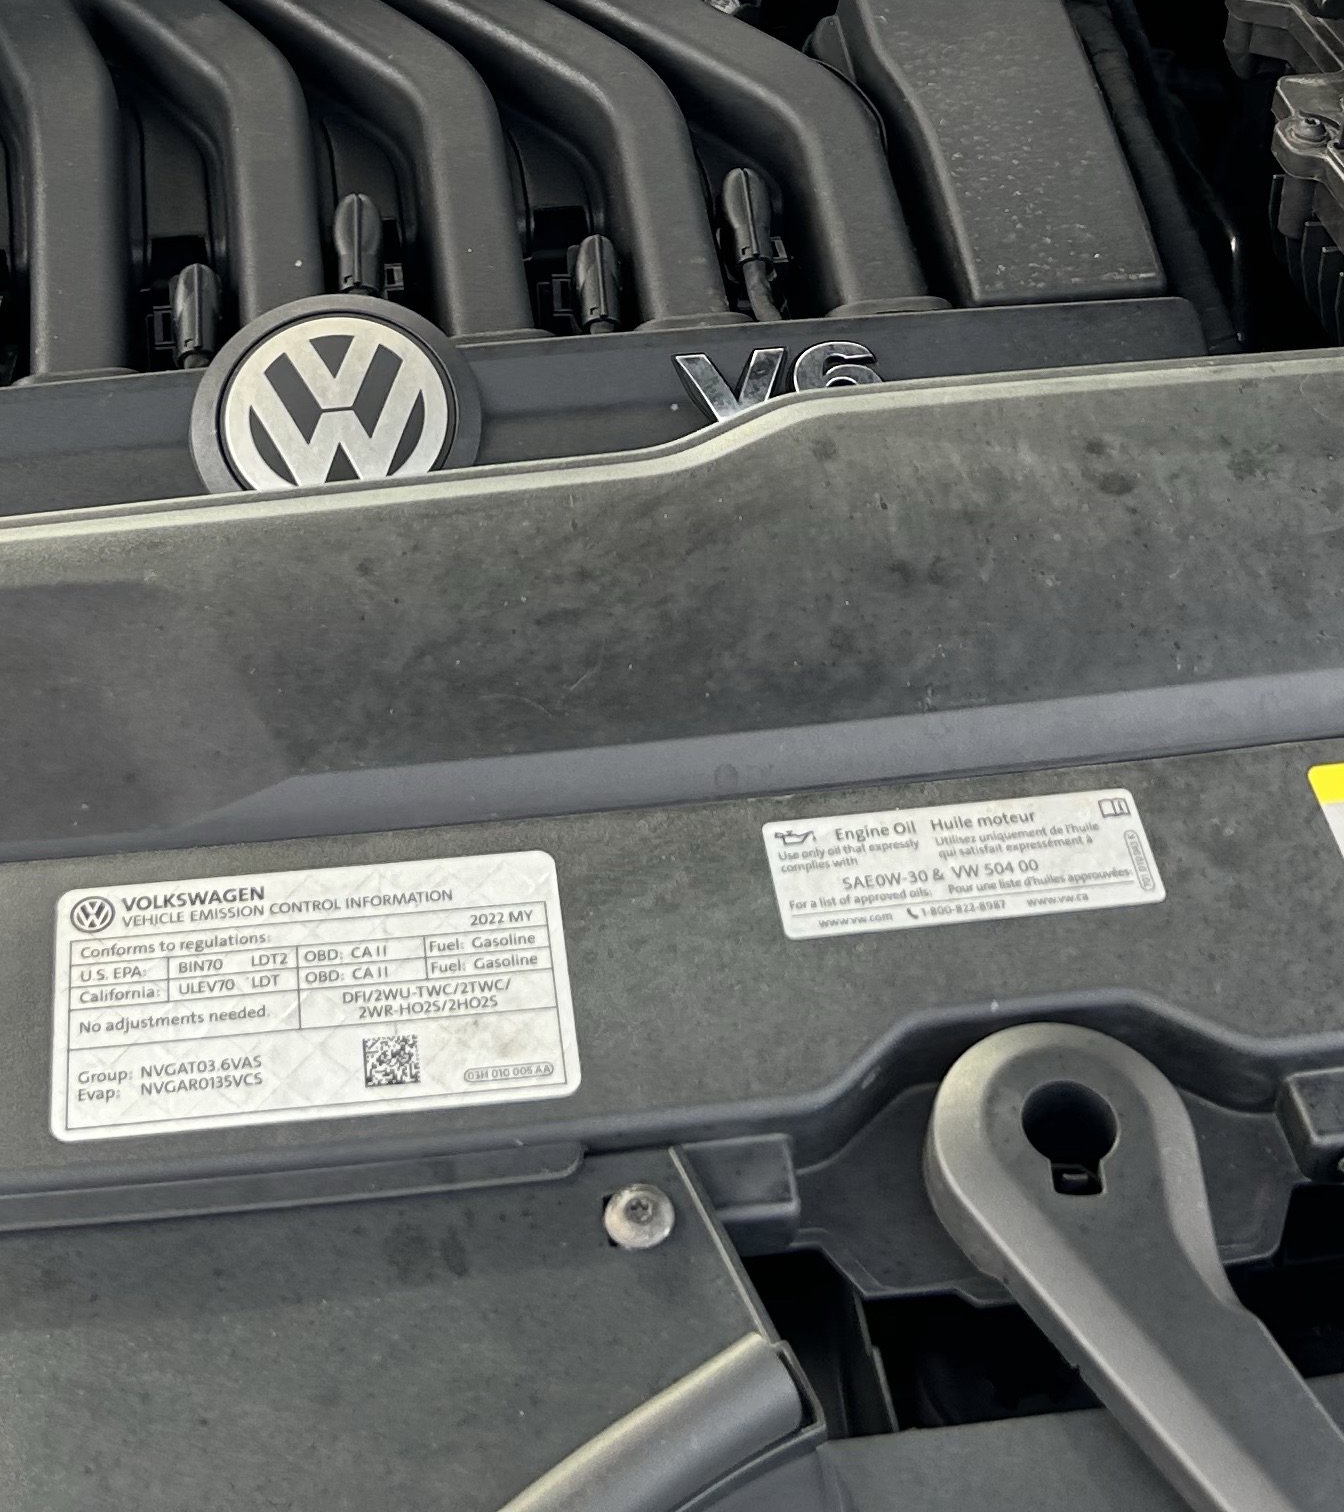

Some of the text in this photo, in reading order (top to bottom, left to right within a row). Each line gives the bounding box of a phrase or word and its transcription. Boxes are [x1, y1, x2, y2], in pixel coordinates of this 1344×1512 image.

[674, 339, 882, 421] V6
[929, 811, 1034, 831] Huile moteur
[834, 820, 916, 842] Engine Oil
[934, 825, 1063, 846] Utilisez uniquement de
[777, 838, 919, 860] Use only oil that expressly
[938, 843, 1002, 860] qui satisfait
[780, 856, 858, 873] complies with
[842, 858, 1039, 890] SAE0W-30 & VW 504 00
[947, 878, 1021, 893] Pour une liste
[121, 886, 264, 911] VOLKSWAGEN
[122, 889, 452, 927] VEHICLE EMISSION CONTROL INFORMATION
[788, 888, 907, 910] For a list of approved
[470, 909, 532, 926] 2022 MY
[80, 933, 270, 958] Conforms to regulations:
[428, 933, 535, 952] Fuel: Gasoline
[251, 952, 287, 966] LDT2
[304, 948, 342, 963] OBD:
[350, 946, 372, 959] CA
[430, 954, 537, 973] Fuel: Gasoline
[80, 965, 146, 982] U.S. EPA:
[178, 958, 222, 973] BIN70
[305, 969, 343, 984] OBD:
[351, 966, 373, 980] CA
[178, 978, 234, 995] ULEV70
[252, 974, 279, 988] LDT
[79, 984, 159, 1003] California:
[342, 978, 510, 1004] DFI/2WU-TWC/2TWC/
[79, 1005, 269, 1033] No adjustments needed.
[77, 1055, 261, 1084] Group: NVGAT03.6VAS
[467, 1064, 550, 1080] 03H 010 005 AA
[77, 1072, 262, 1103] Evap: NVGAR0135VCS
